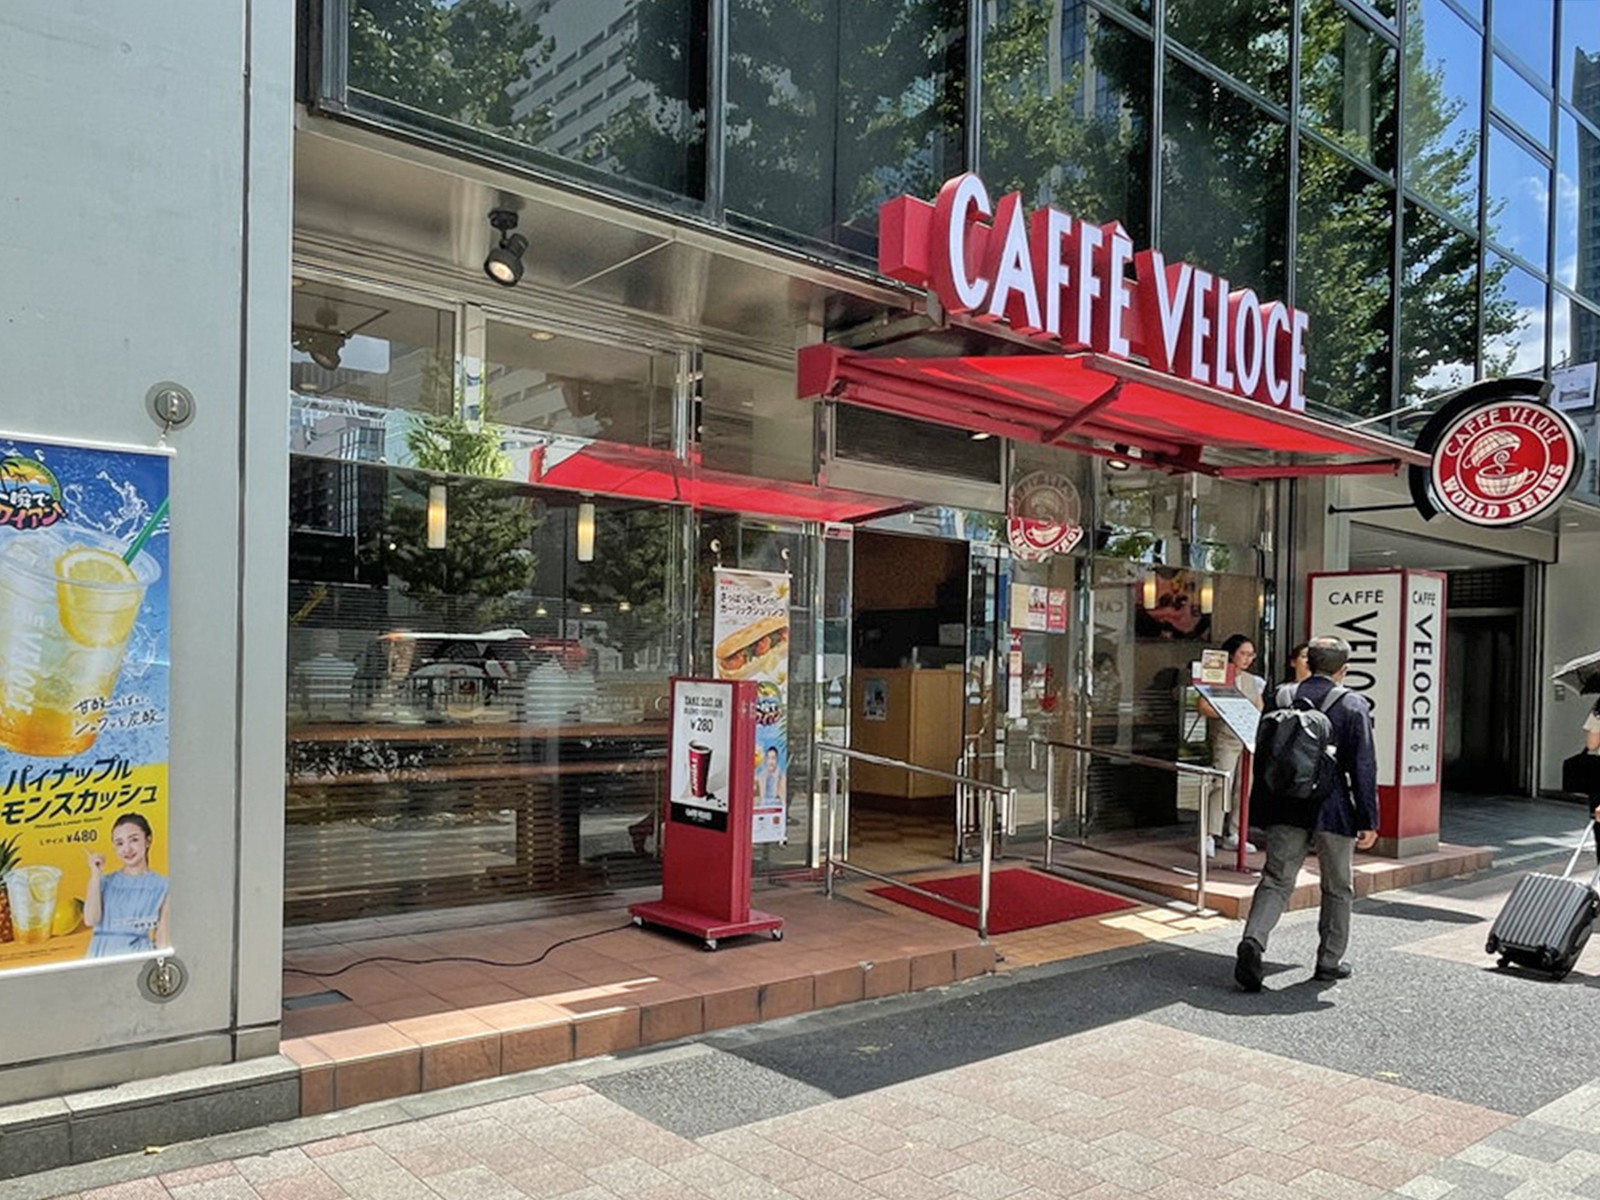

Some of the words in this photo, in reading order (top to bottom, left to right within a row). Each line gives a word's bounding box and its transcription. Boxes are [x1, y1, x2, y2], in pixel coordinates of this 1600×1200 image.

[1152, 250, 1308, 411] VELOCE
[1445, 408, 1501, 457] CAFFE
[1509, 407, 1564, 444] VELOCE
[1442, 475, 1500, 518] WORLD
[1507, 464, 1565, 516] BEANS
[1410, 613, 1433, 731] VELOCE
[2, 754, 132, 796] パイナップル
[66, 829, 97, 843] ¥480
